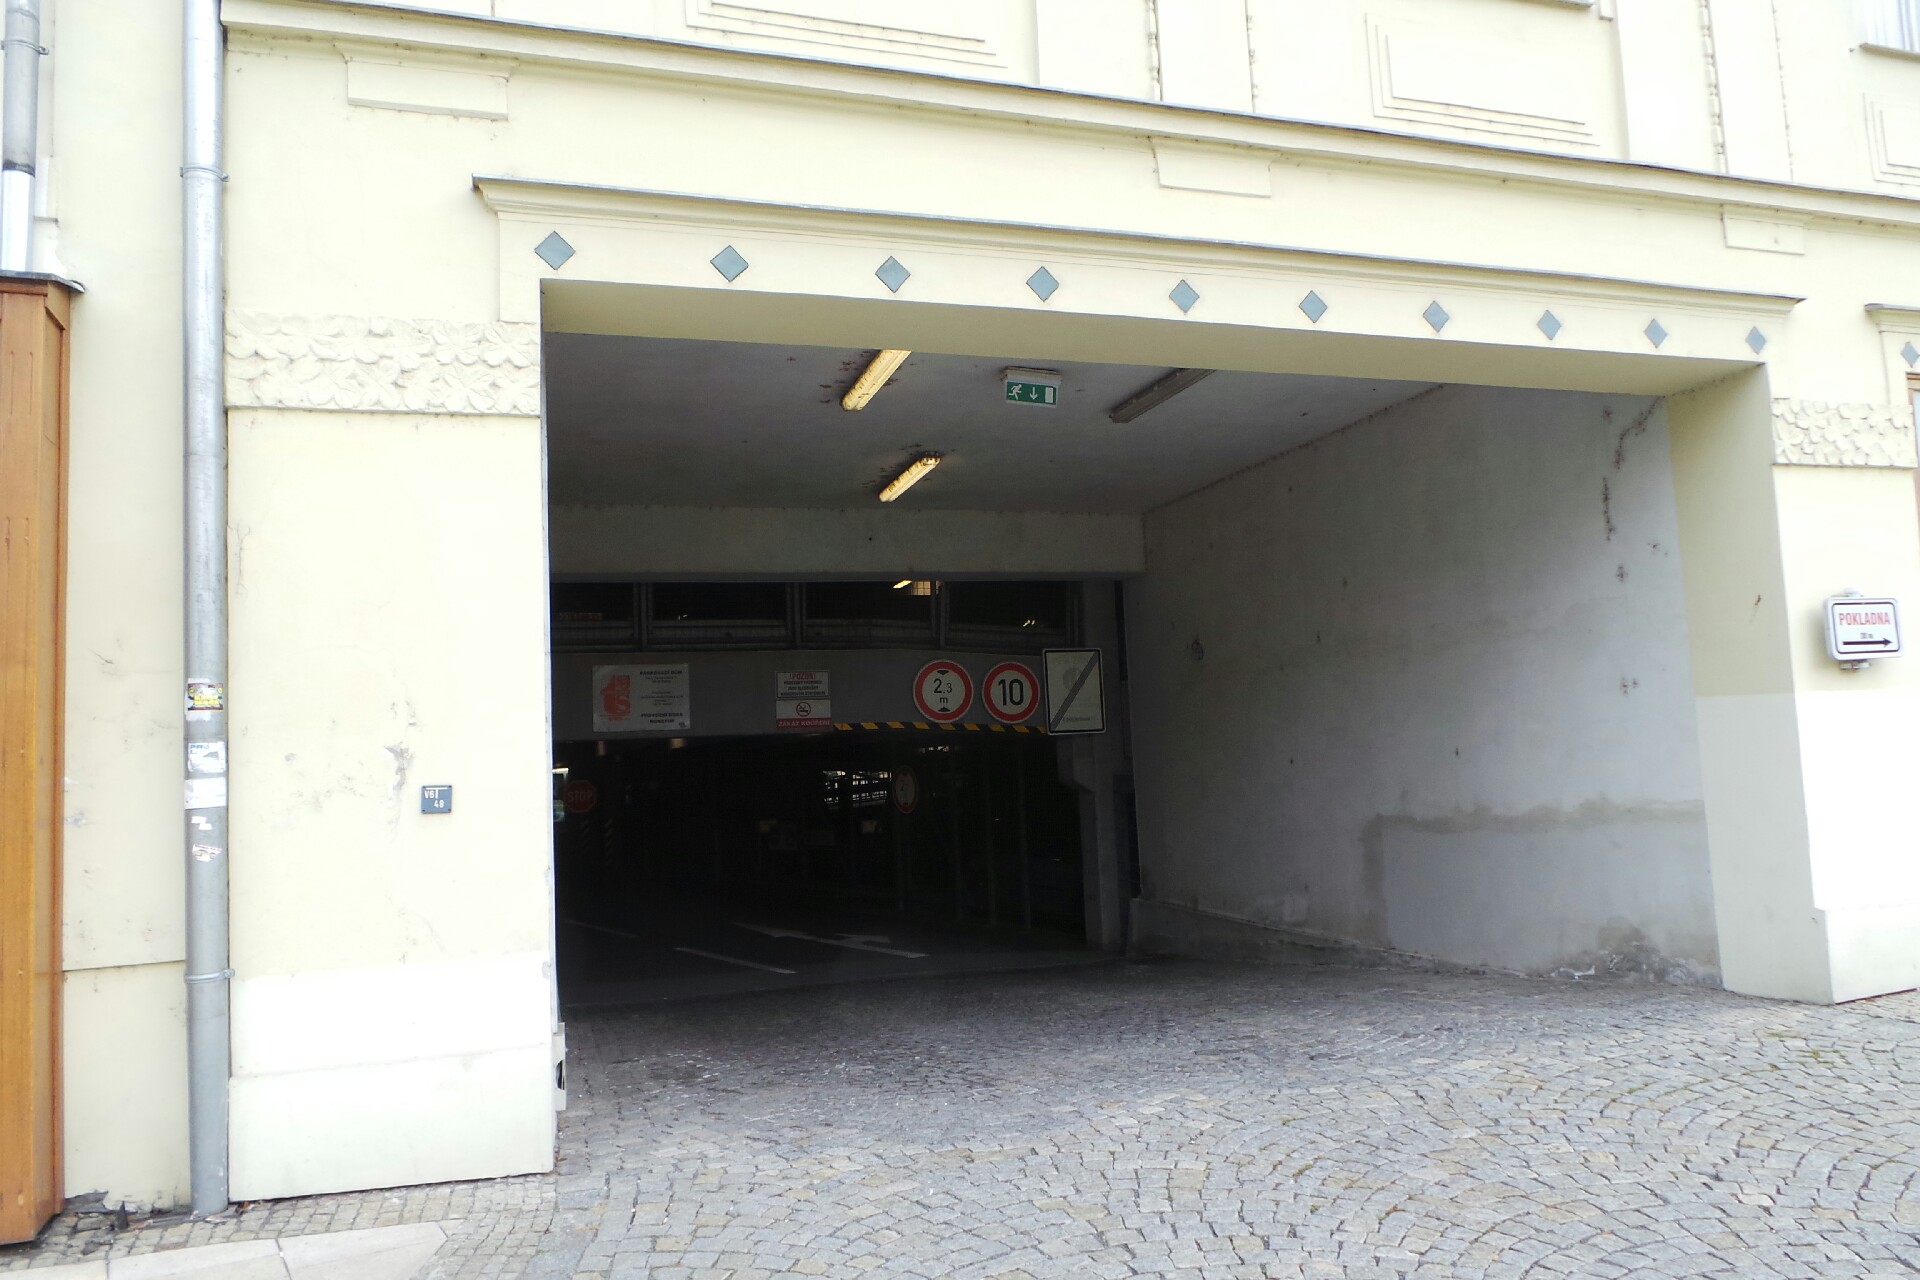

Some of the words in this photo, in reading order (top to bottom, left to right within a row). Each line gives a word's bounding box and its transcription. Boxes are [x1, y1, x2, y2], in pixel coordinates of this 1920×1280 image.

[1838, 612, 1891, 626] POKLADNA
[997, 678, 1024, 706] 10
[567, 789, 593, 803] STOP
[433, 799, 445, 808] 48
